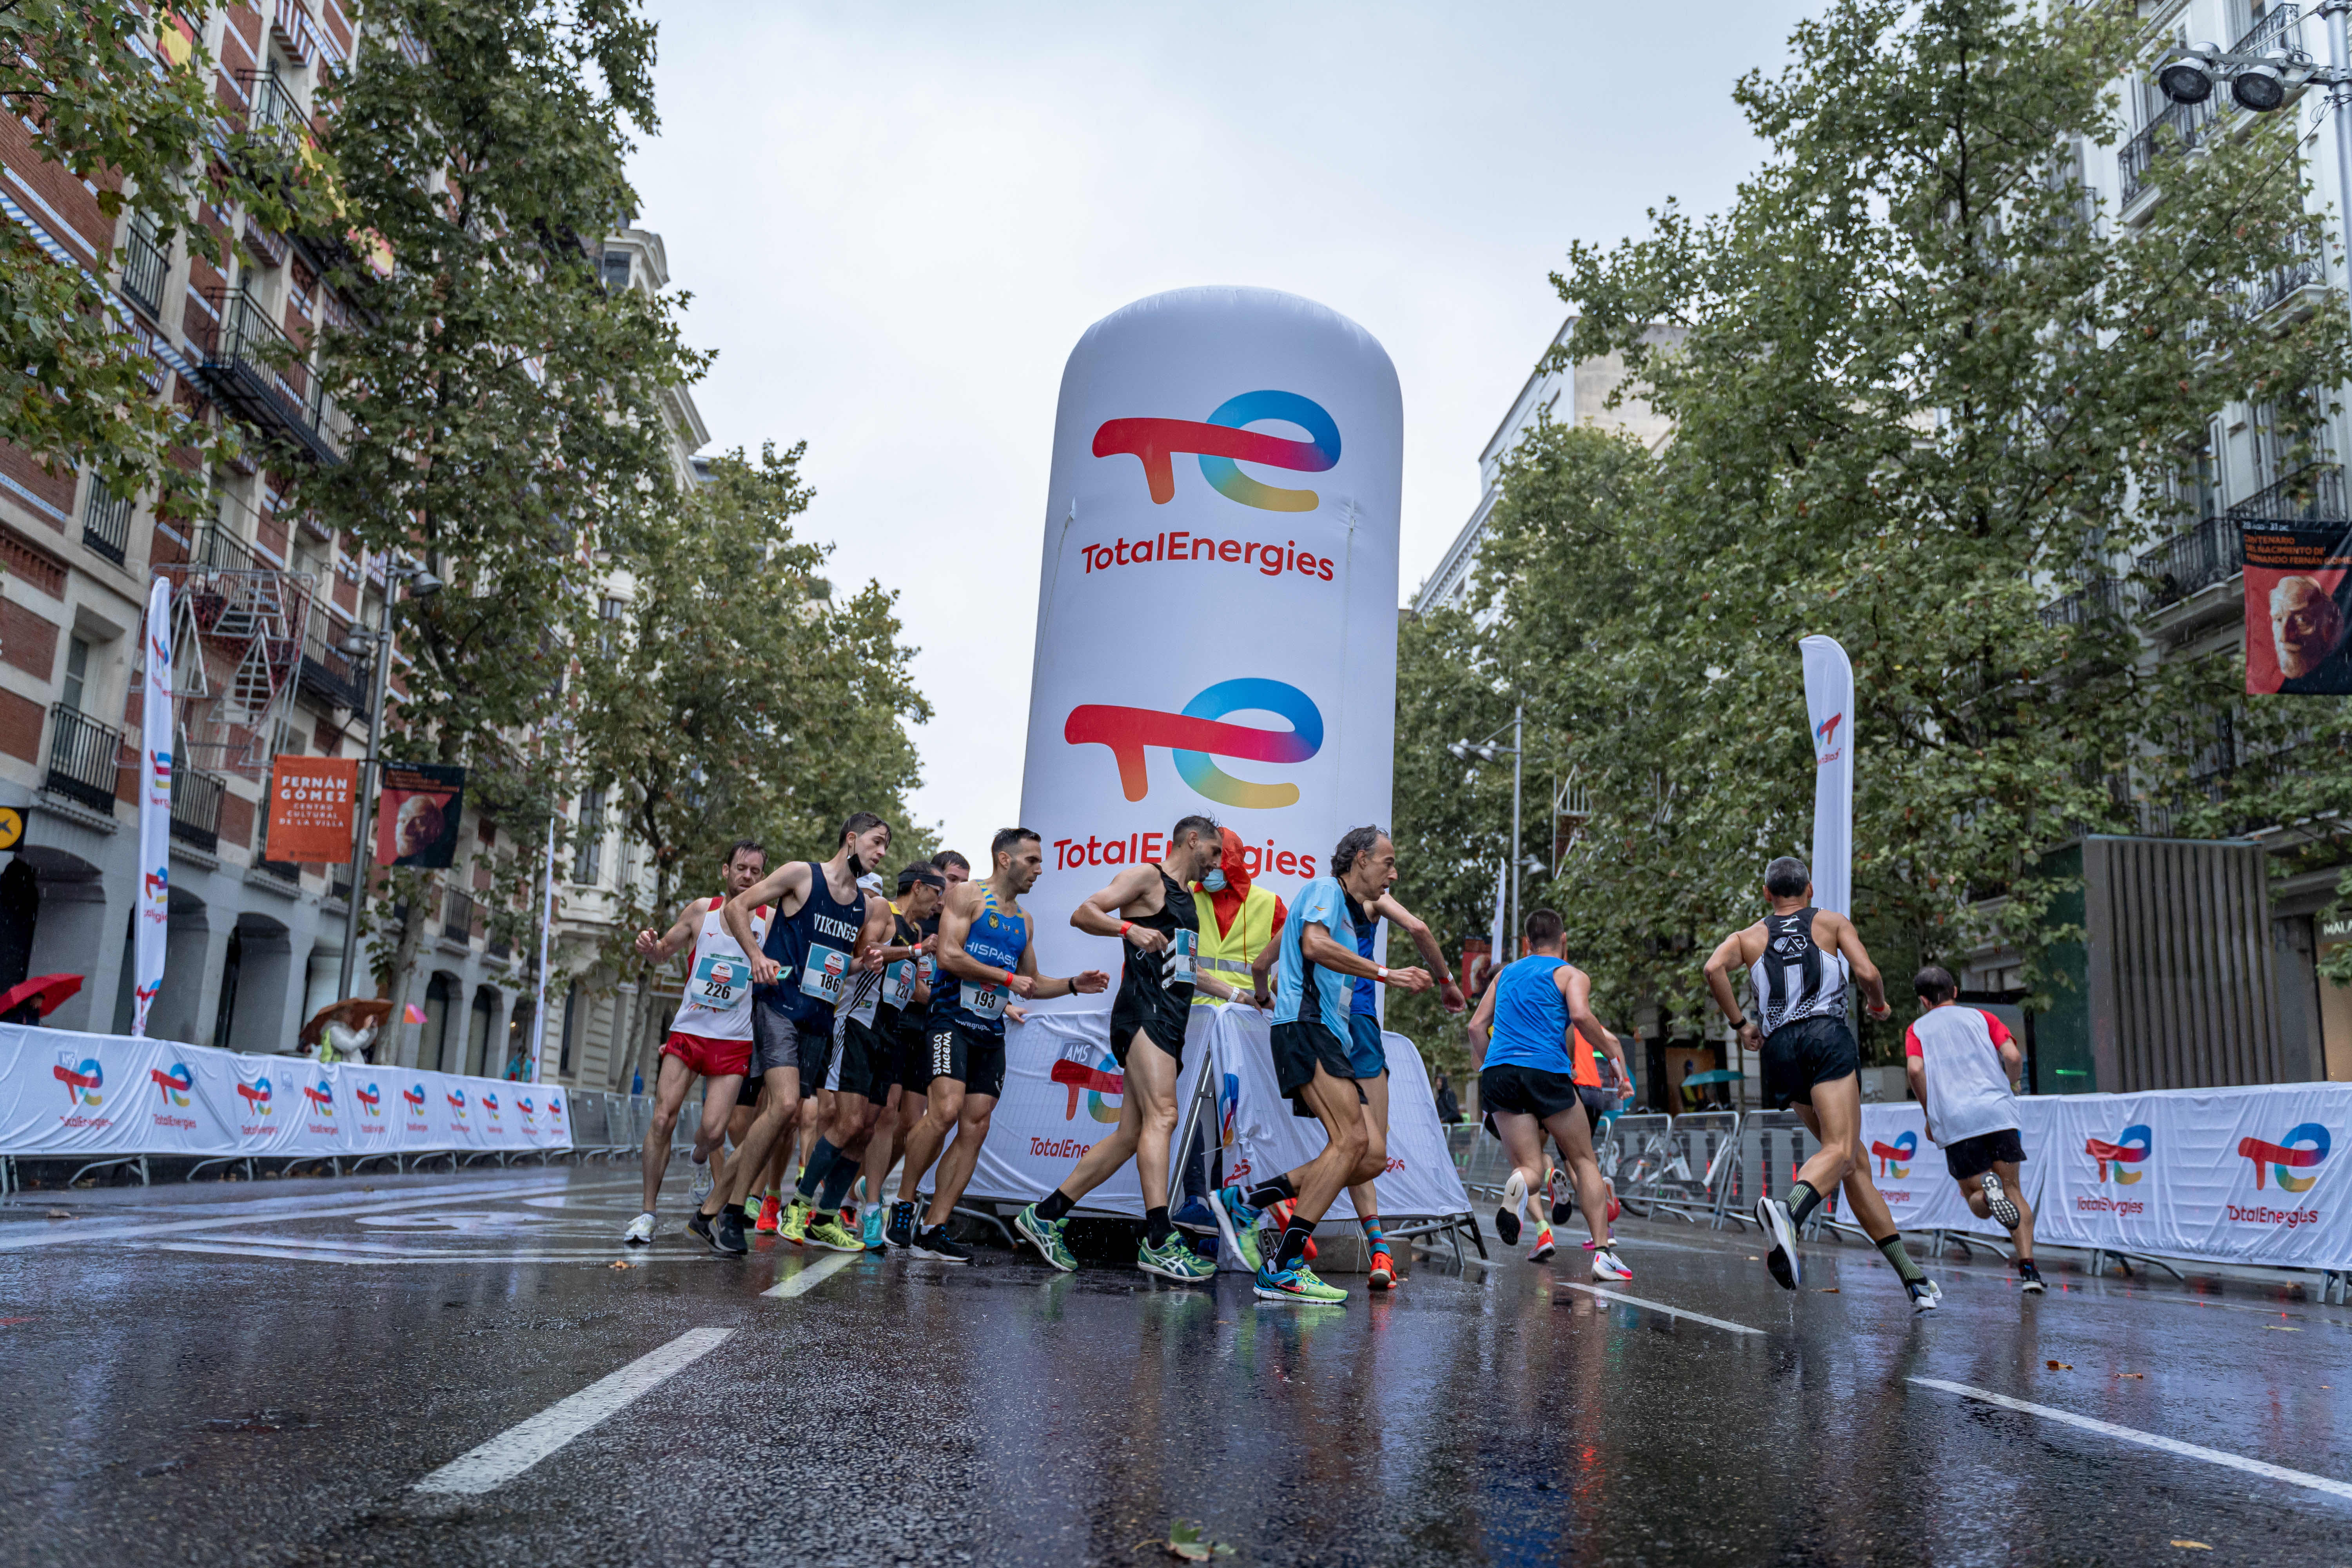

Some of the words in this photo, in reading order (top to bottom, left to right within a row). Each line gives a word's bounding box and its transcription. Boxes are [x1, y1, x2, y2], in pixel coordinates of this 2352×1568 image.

[1082, 532, 1334, 581] TotalEnergies
[281, 775, 348, 789] FERNÁN
[280, 786, 347, 803] GÓMEZ
[286, 810, 338, 819] CULTURAL
[293, 803, 334, 811] CENTRO
[315, 819, 344, 828] VILLA
[814, 913, 858, 942] VIKINGS
[704, 982, 731, 1000] 226
[820, 973, 841, 993] 186
[895, 982, 910, 1002] 224
[974, 991, 996, 1009] 193
[933, 1034, 942, 1075] SURCO
[942, 1032, 952, 1074] LUCENA
[1064, 1044, 1091, 1062] AMS
